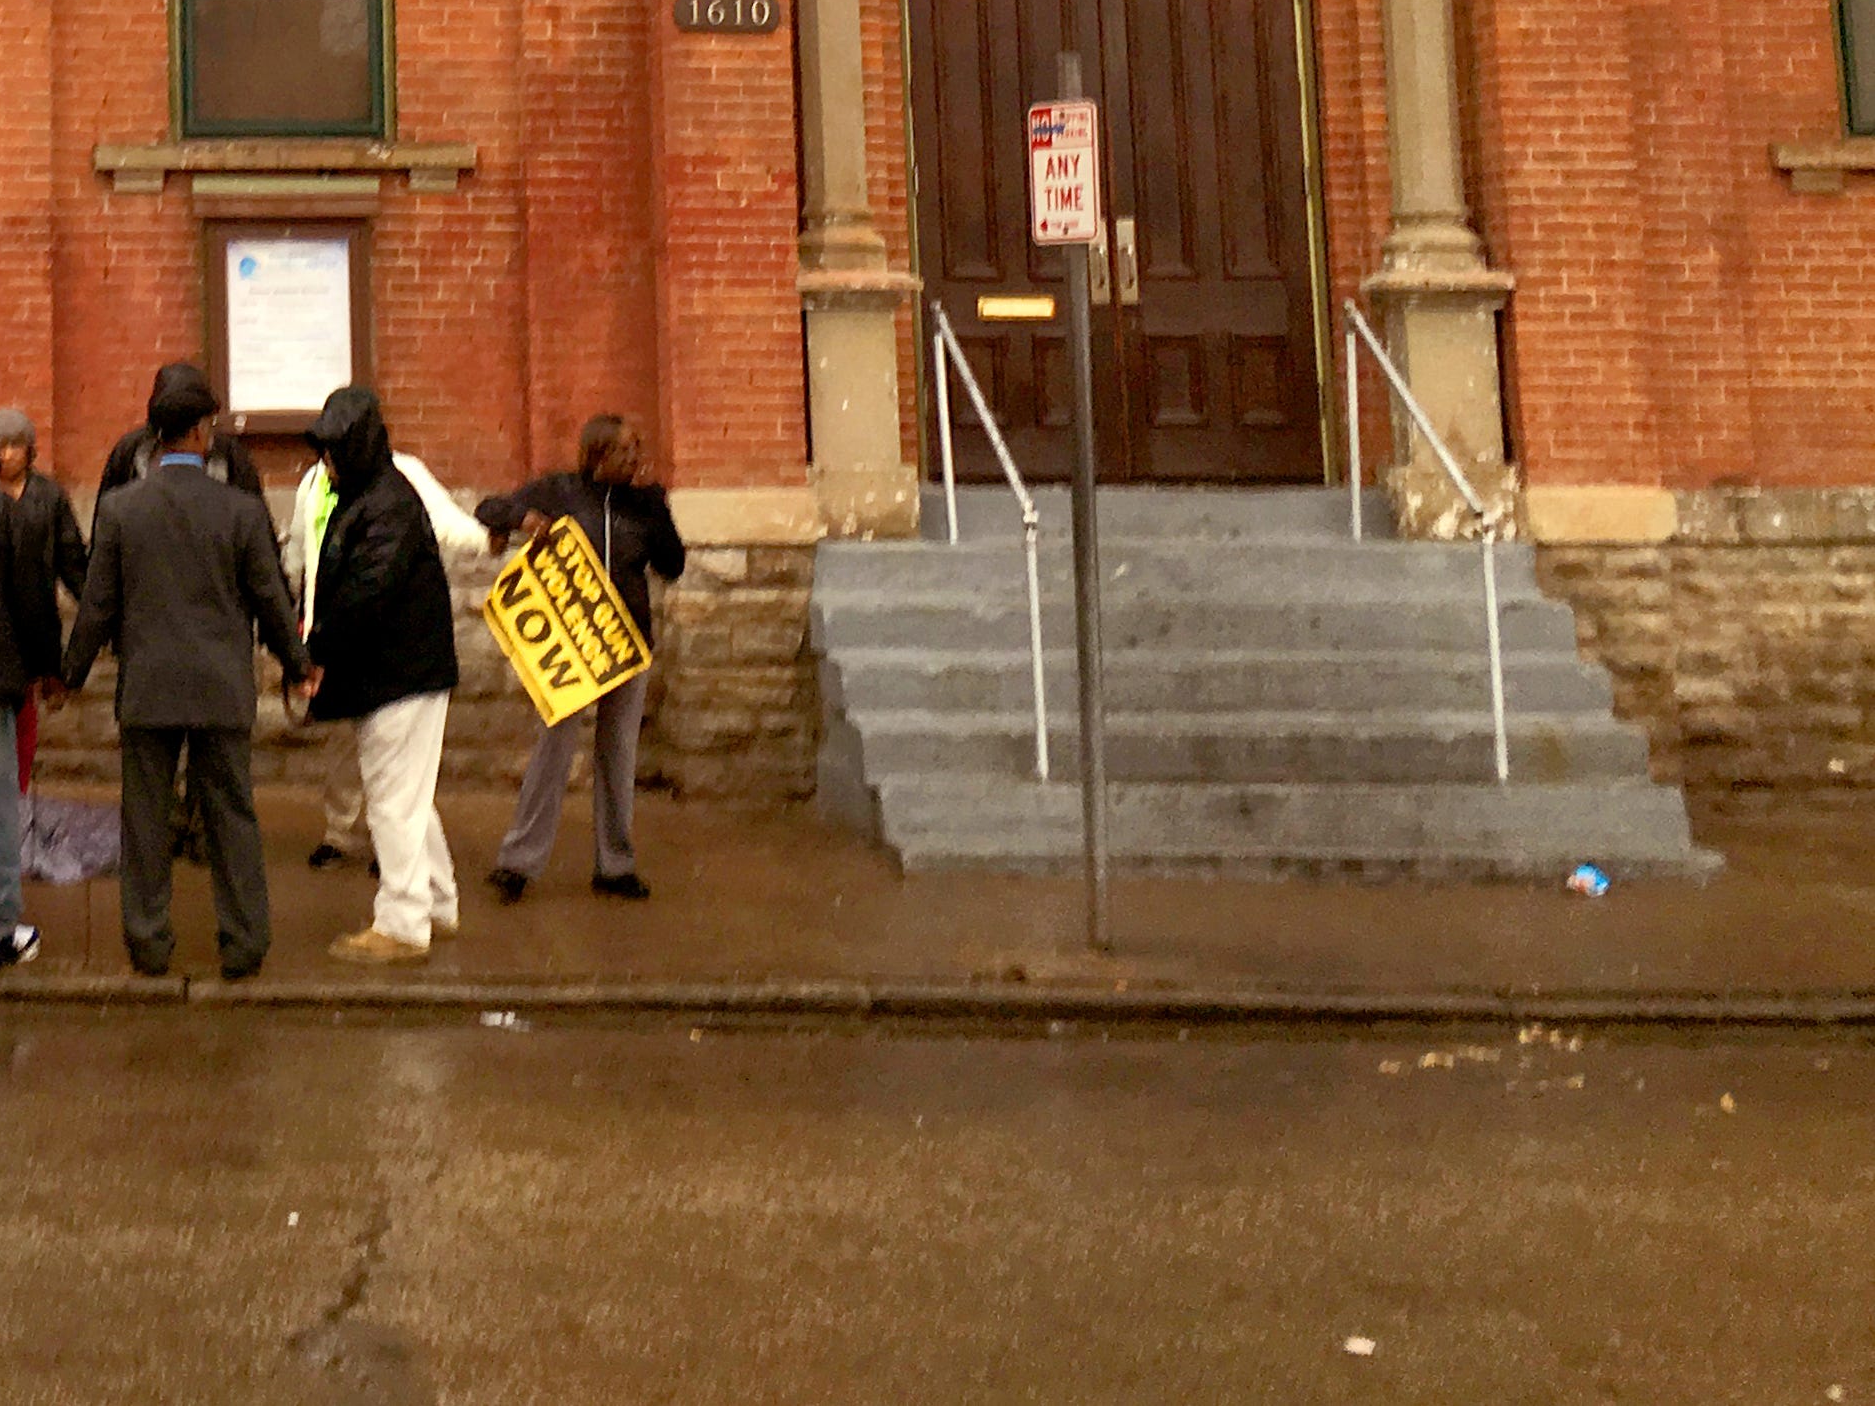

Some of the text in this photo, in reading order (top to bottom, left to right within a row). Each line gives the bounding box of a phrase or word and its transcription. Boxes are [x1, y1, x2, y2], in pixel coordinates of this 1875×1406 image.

[1032, 114, 1051, 143] NO
[1044, 186, 1084, 212] TIME
[1045, 154, 1080, 180] ANY
[501, 566, 581, 689] NOW
[532, 546, 615, 678] VIOLENCE
[555, 531, 636, 664] STOP GUN
